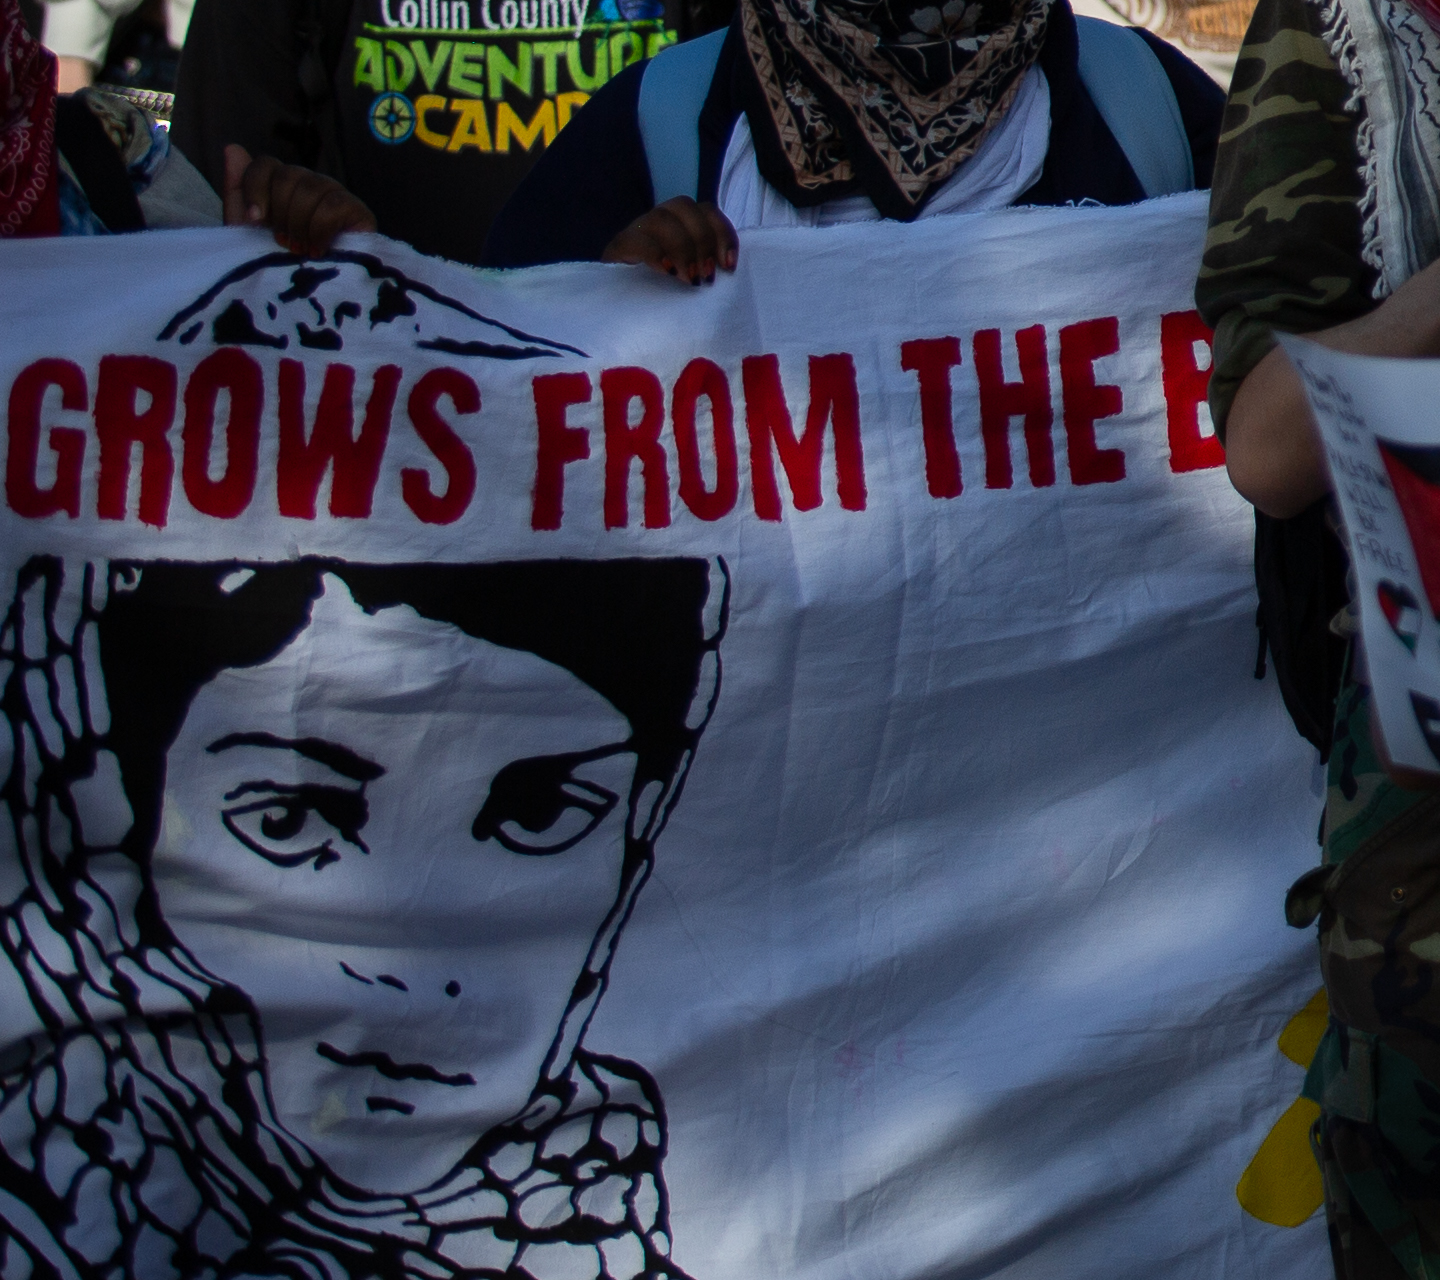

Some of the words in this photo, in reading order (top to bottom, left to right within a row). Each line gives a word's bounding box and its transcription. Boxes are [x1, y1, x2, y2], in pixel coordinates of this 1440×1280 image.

[4, 348, 482, 528] GROWS
[531, 351, 867, 532] FROM
[902, 316, 1127, 500] THE
